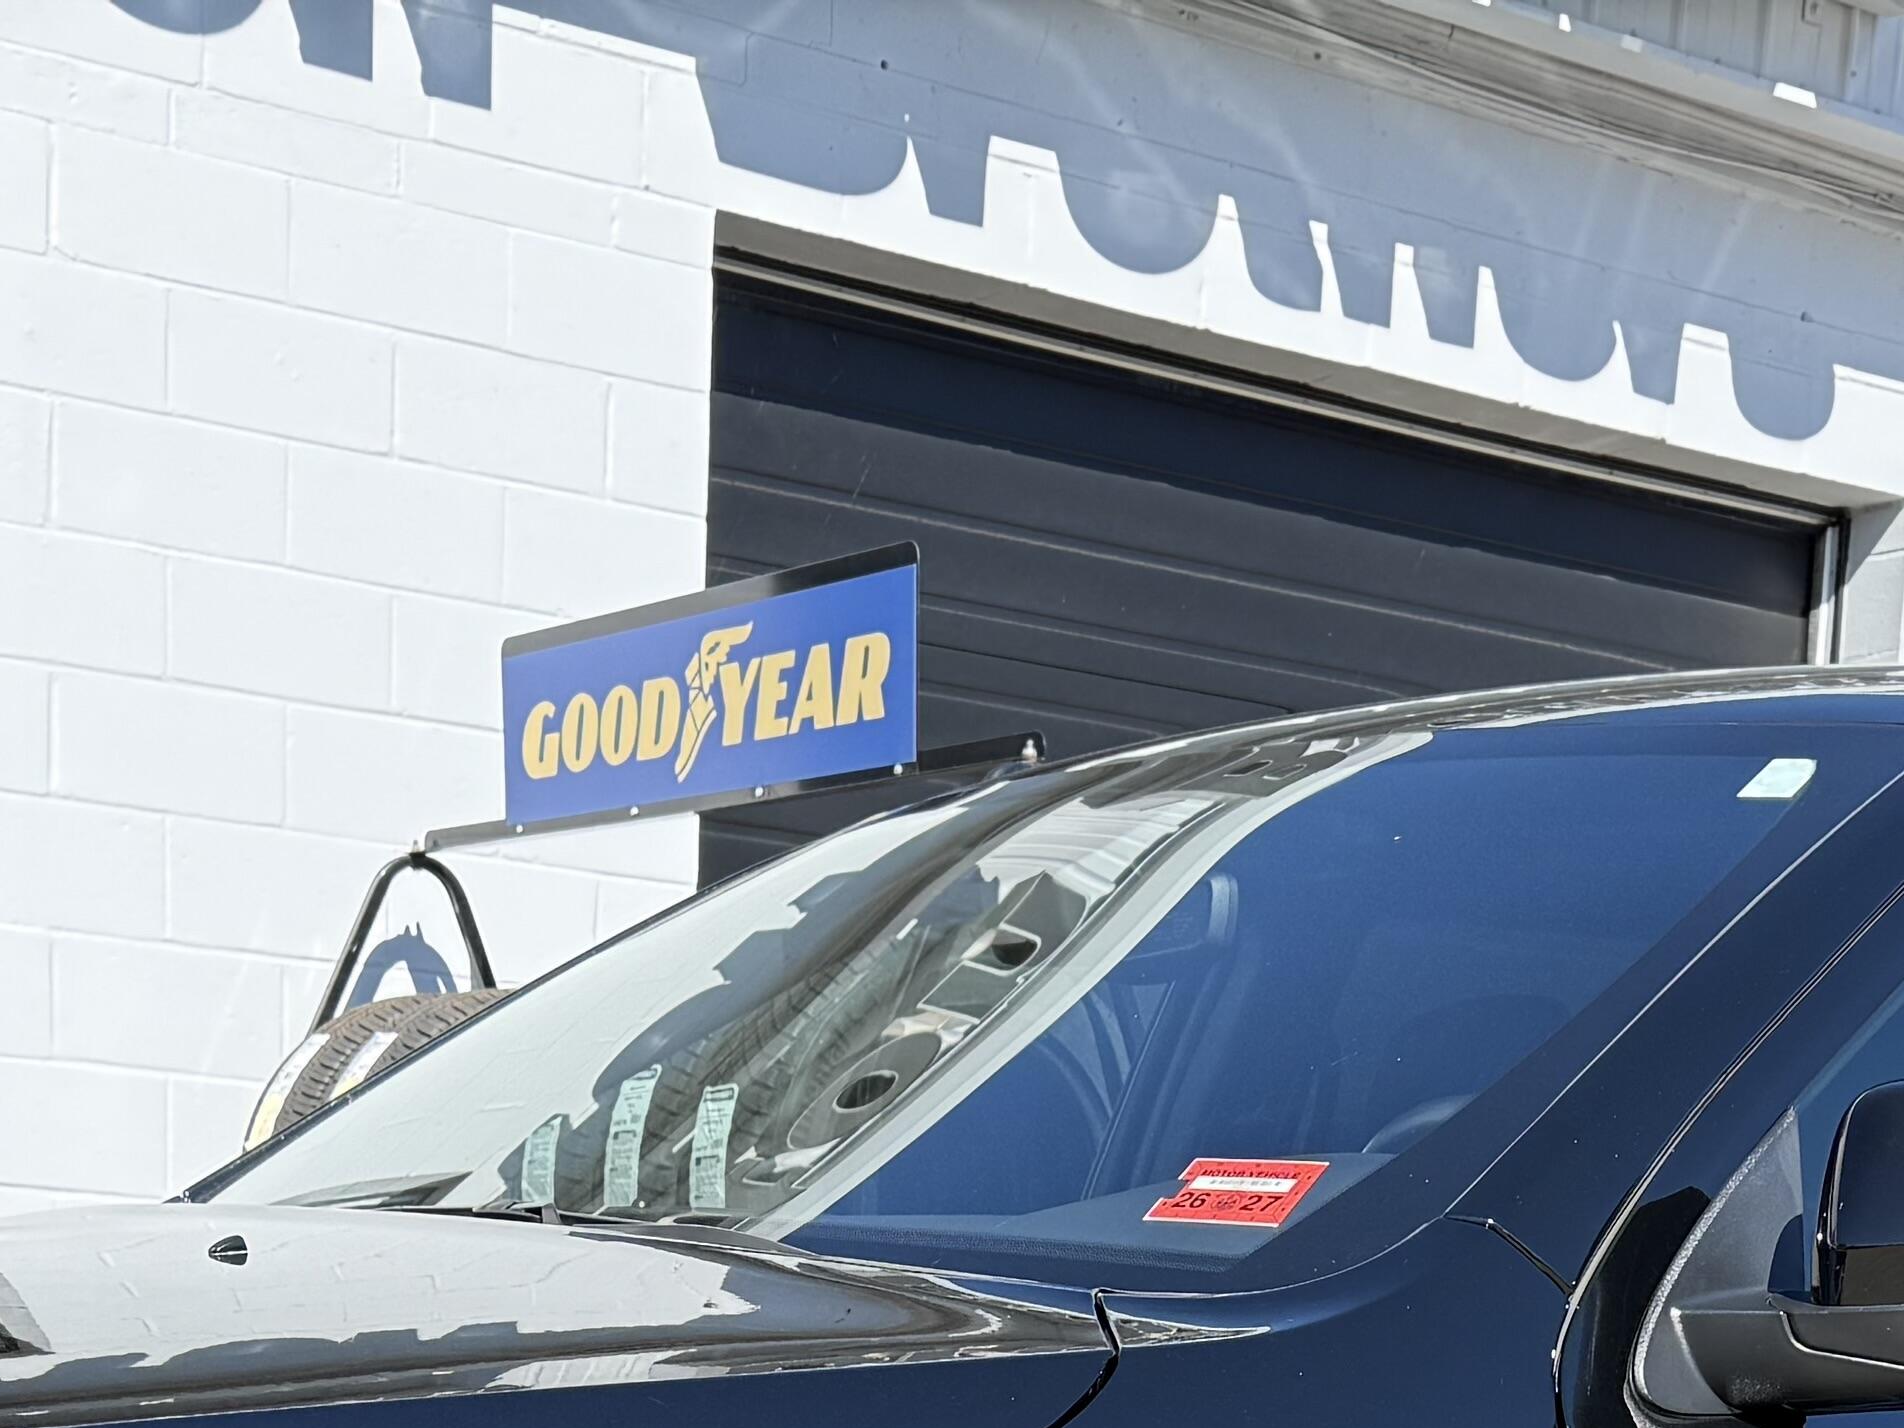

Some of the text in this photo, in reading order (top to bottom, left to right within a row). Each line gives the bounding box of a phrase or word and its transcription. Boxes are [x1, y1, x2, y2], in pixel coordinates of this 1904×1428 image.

[521, 632, 892, 781] GOODYEAR
[1201, 1168, 1246, 1178] MOTOR
[1171, 1192, 1284, 1212] 26 27
